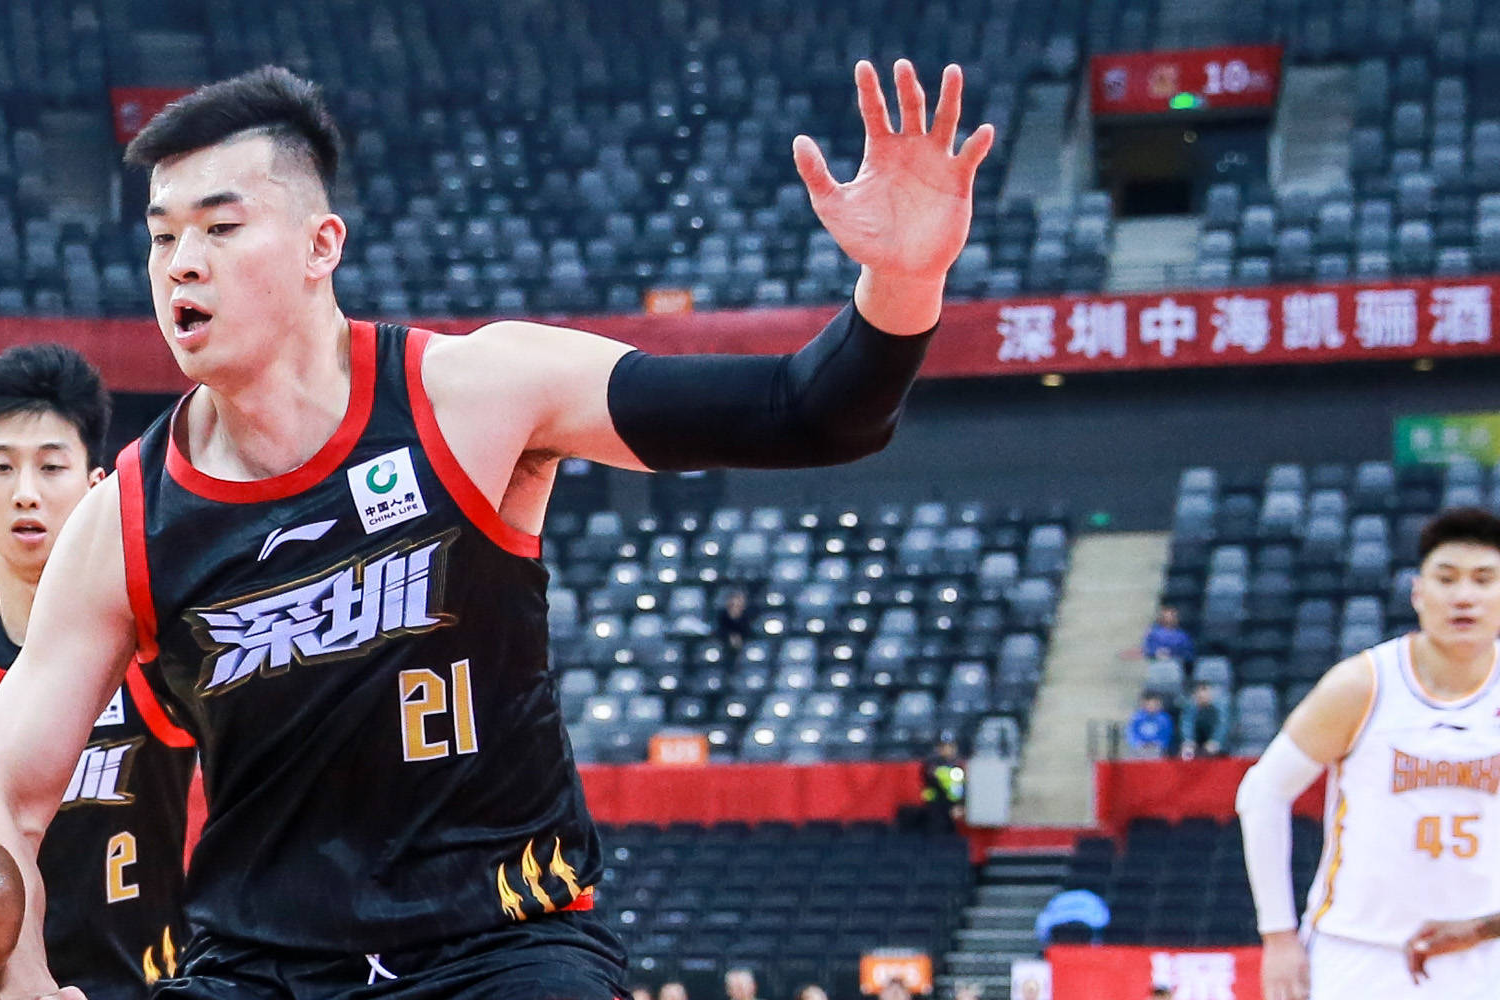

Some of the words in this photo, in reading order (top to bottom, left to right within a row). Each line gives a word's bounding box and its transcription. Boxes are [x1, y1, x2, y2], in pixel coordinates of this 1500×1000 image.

[369, 511, 397, 526] CHINA
[398, 503, 419, 515] LIFE
[197, 541, 442, 691] 深圳
[399, 658, 479, 762] 21
[106, 831, 139, 904] 2
[1416, 815, 1481, 860] 45
